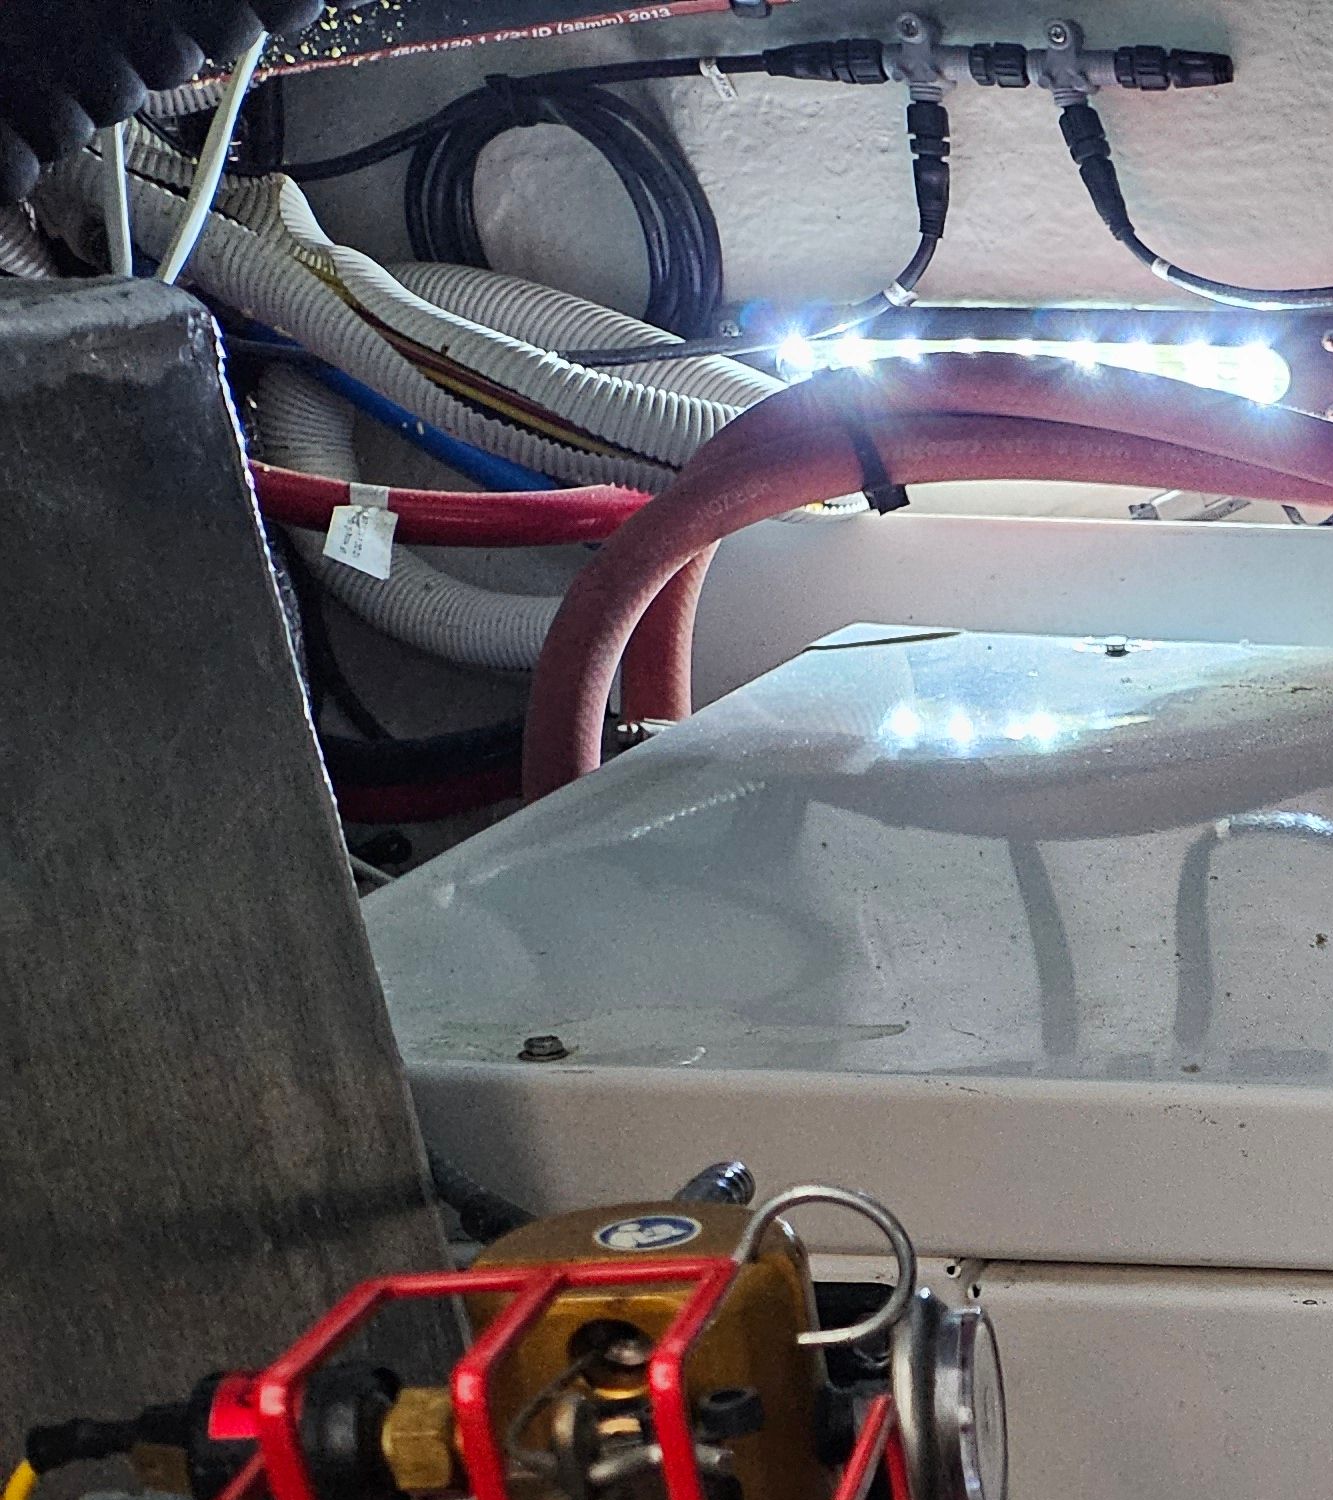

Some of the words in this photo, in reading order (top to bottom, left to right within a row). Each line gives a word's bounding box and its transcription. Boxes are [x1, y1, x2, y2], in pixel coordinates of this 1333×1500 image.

[532, 23, 552, 38] ID
[557, 14, 624, 35] (38mm)
[628, 8, 671, 23] 2013
